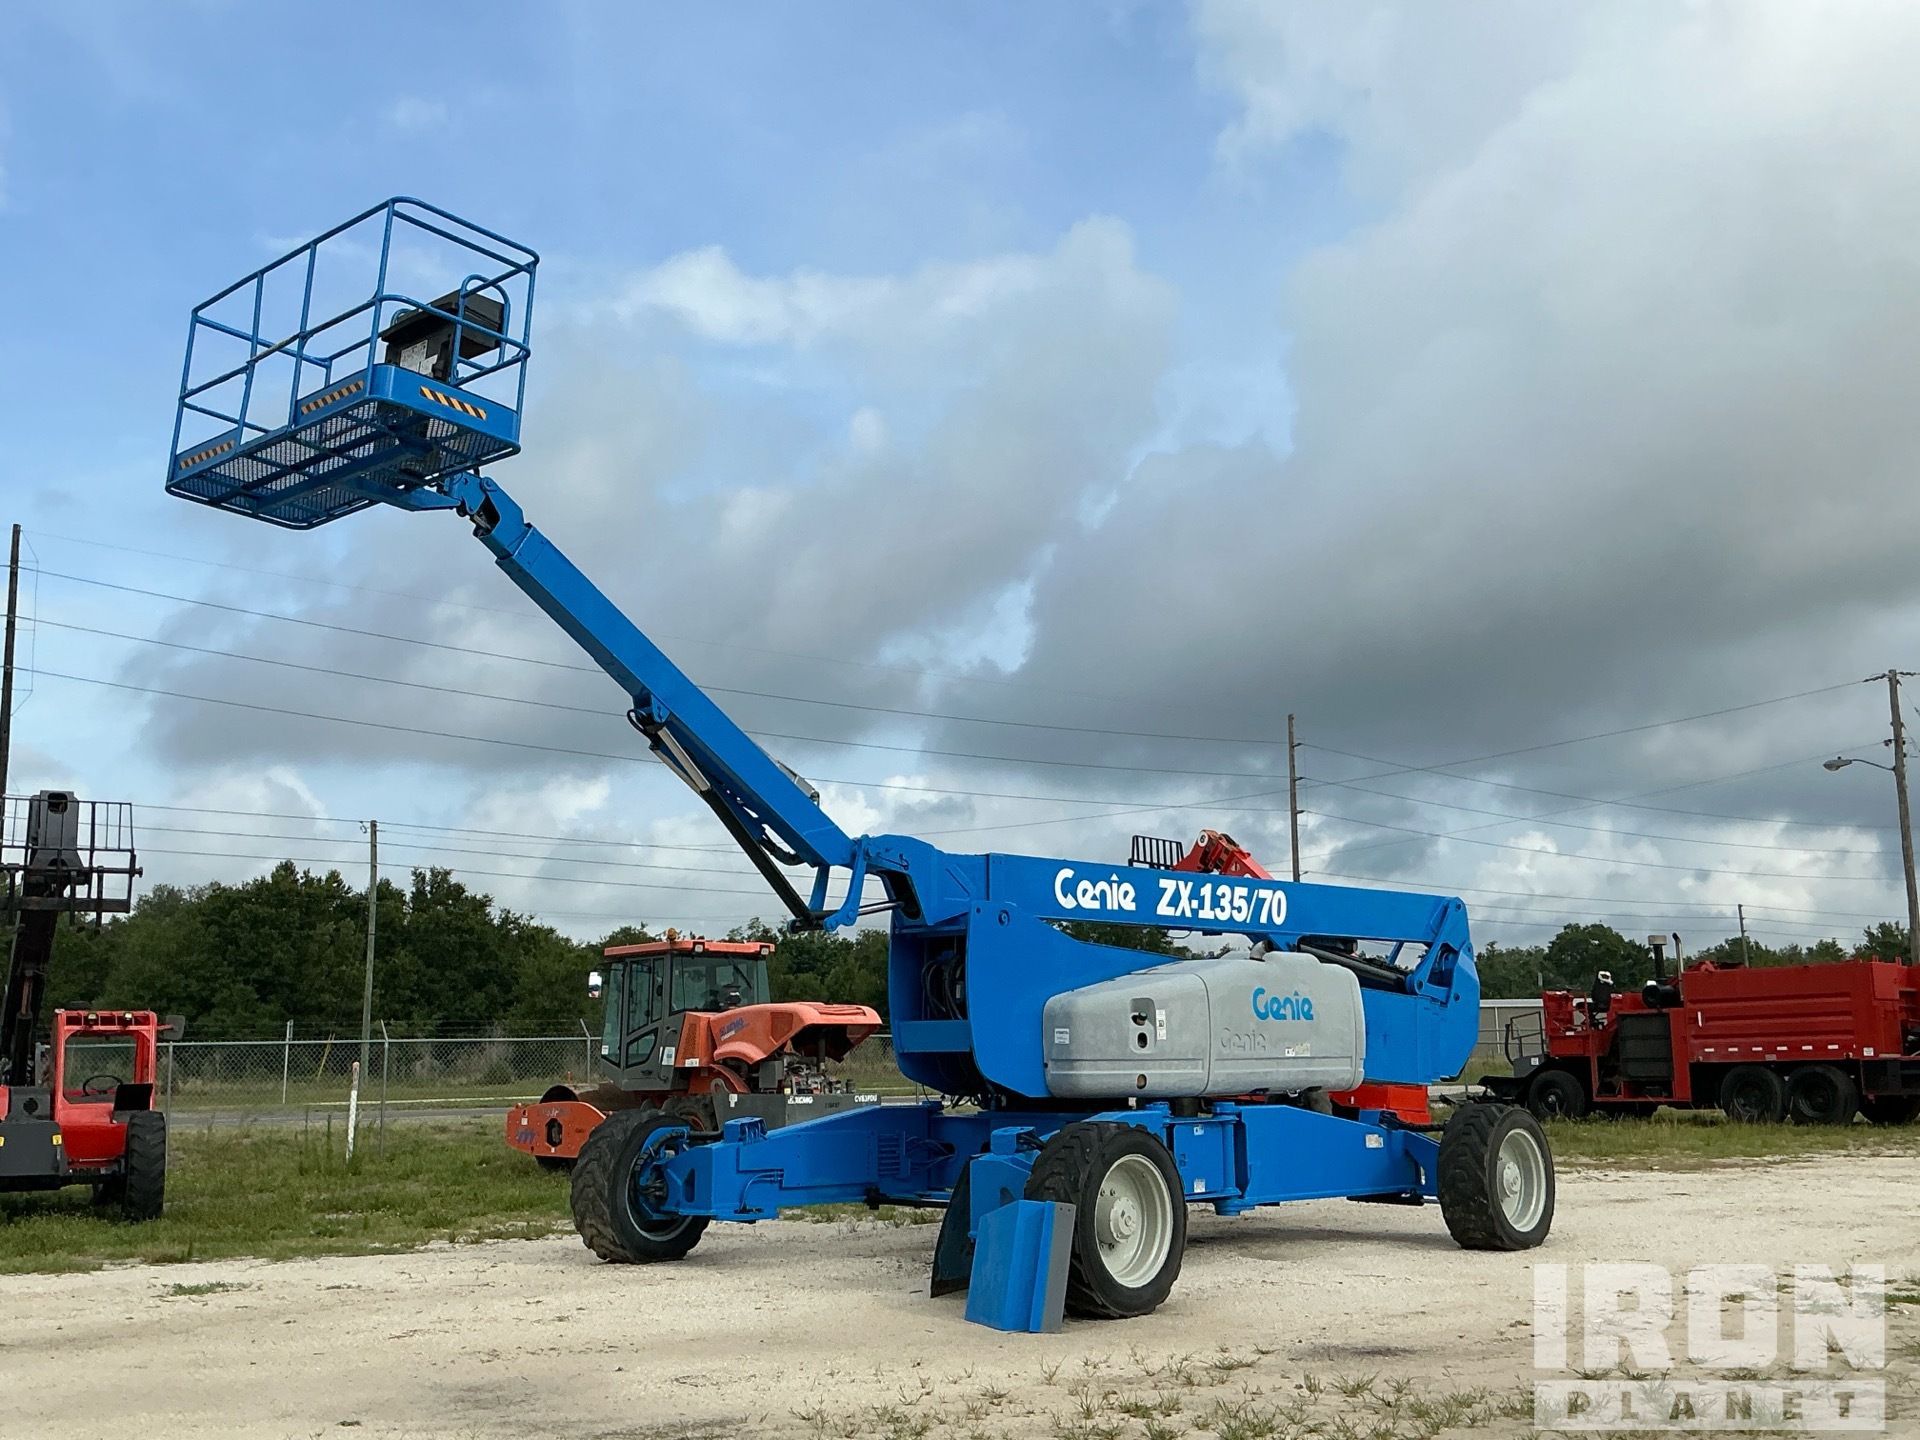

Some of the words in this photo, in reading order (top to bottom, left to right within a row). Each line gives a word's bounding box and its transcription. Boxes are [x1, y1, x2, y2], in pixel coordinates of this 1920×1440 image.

[1054, 868, 1137, 911] Genie
[1156, 878, 1288, 926] ZX-135/70
[1252, 987, 1314, 1021] Genie
[1220, 1027, 1267, 1052] Genie
